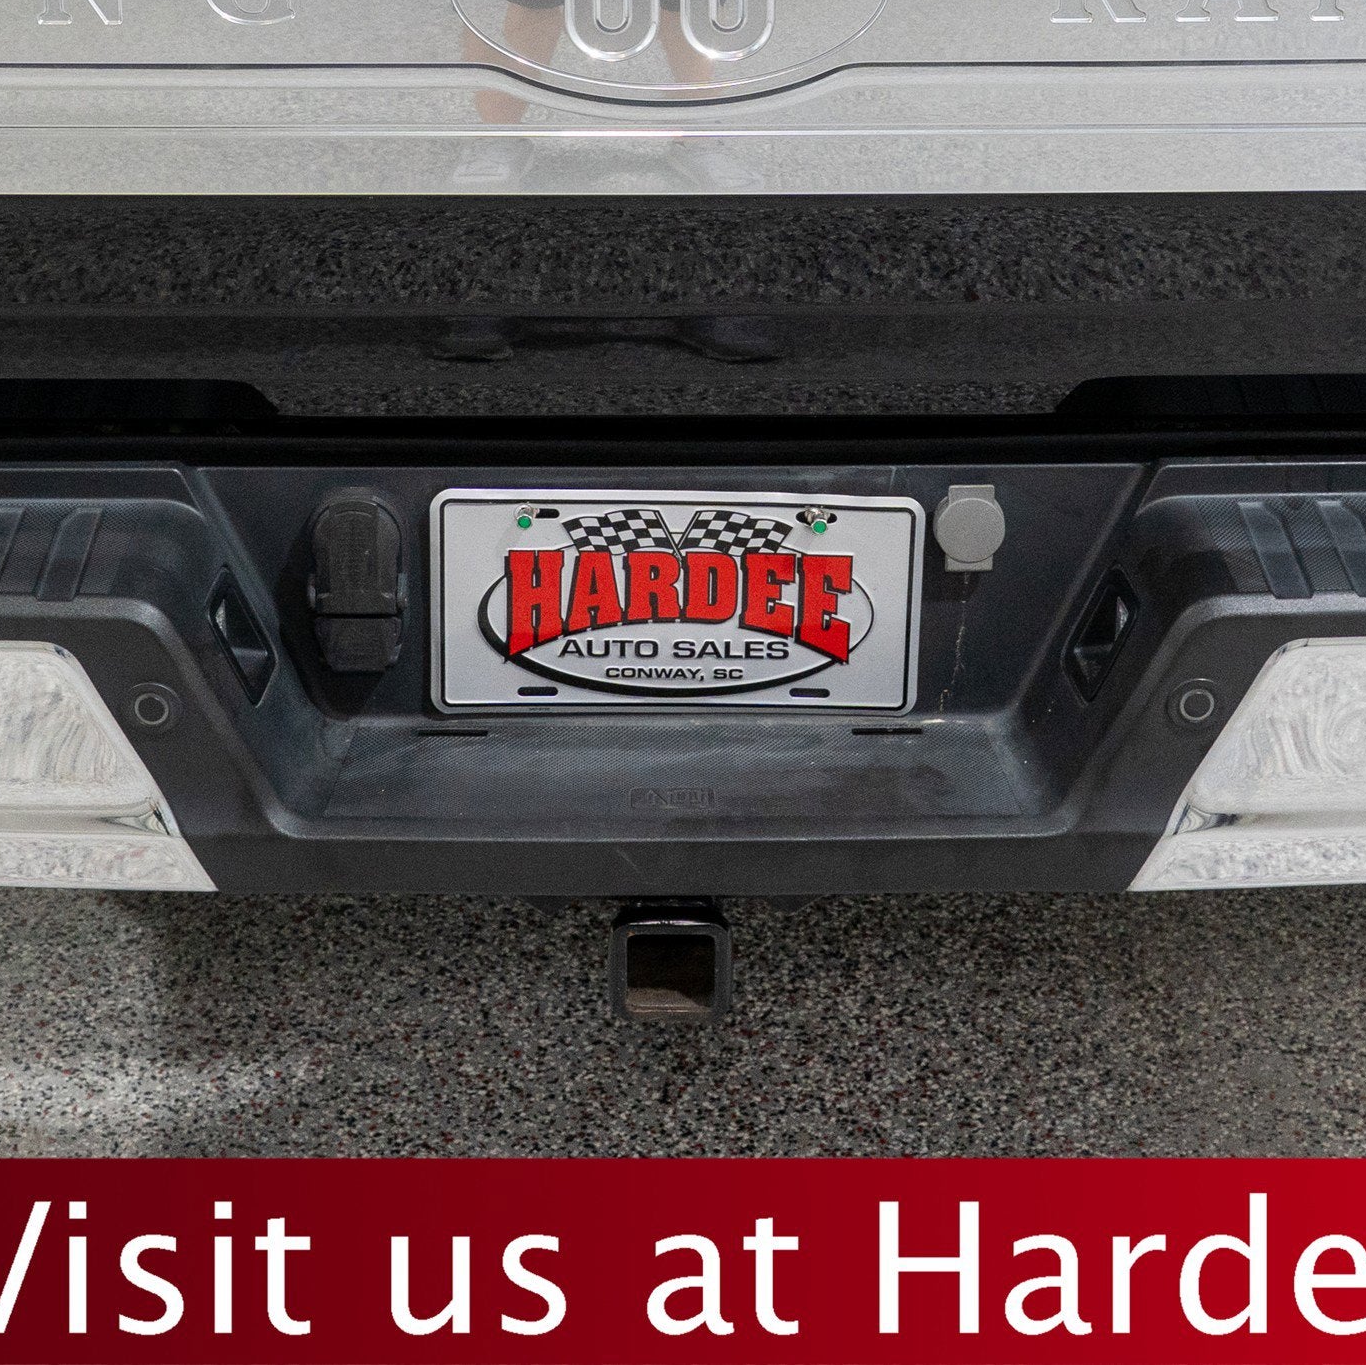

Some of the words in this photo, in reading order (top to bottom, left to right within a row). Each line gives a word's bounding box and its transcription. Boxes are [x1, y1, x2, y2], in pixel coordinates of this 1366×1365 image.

[504, 550, 853, 663] HARDEE
[557, 639, 659, 660] AUTO
[672, 641, 790, 660] SALES
[605, 667, 706, 682] CONWAY,
[713, 668, 744, 680] SC
